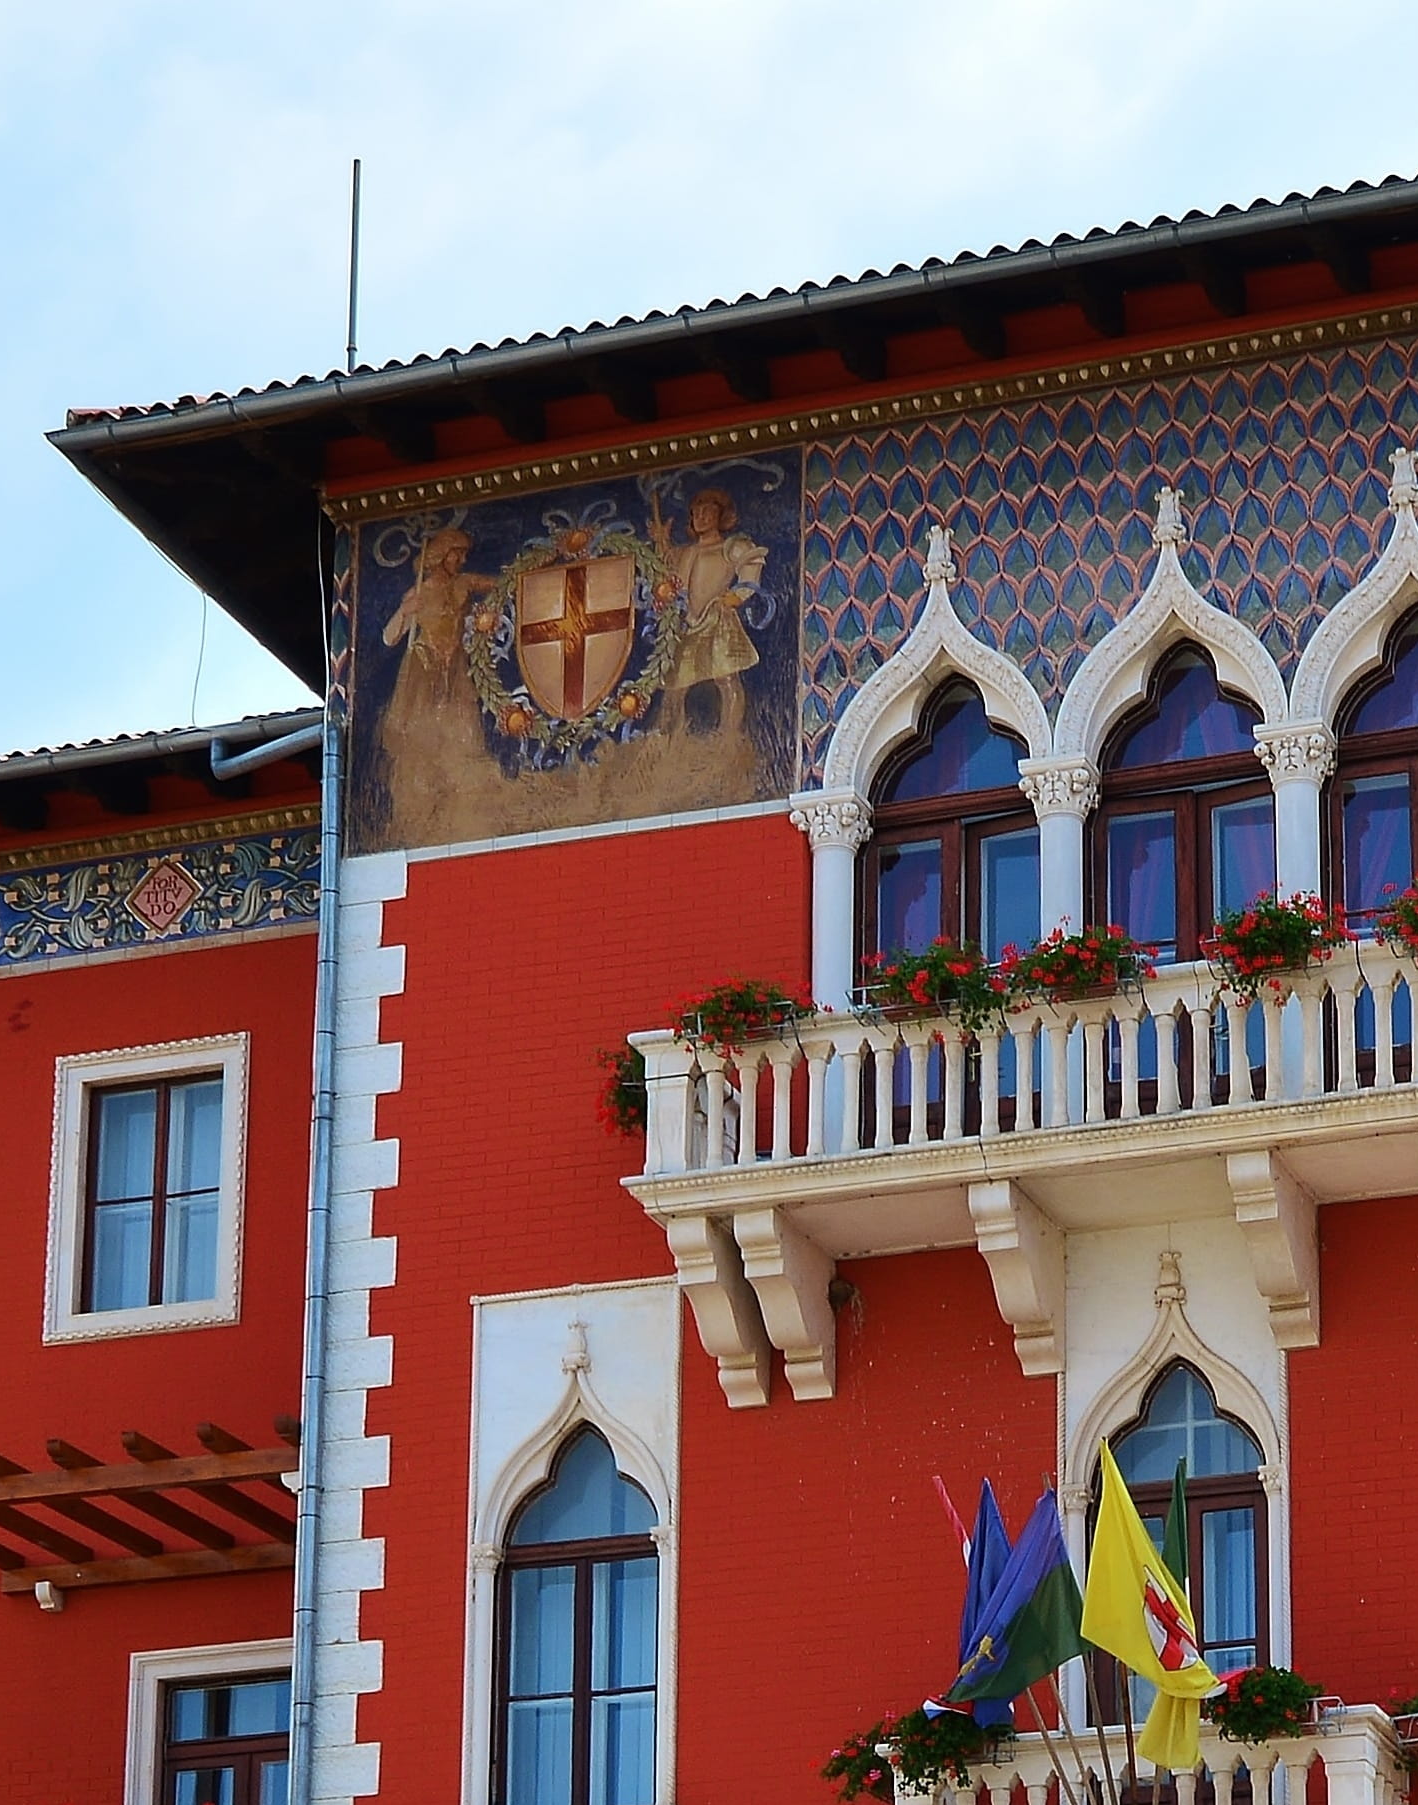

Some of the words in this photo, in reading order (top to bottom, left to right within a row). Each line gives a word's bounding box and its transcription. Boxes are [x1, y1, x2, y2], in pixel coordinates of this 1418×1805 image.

[152, 874, 178, 890] FOR
[144, 887, 183, 904] TITV
[150, 901, 176, 917] DO
